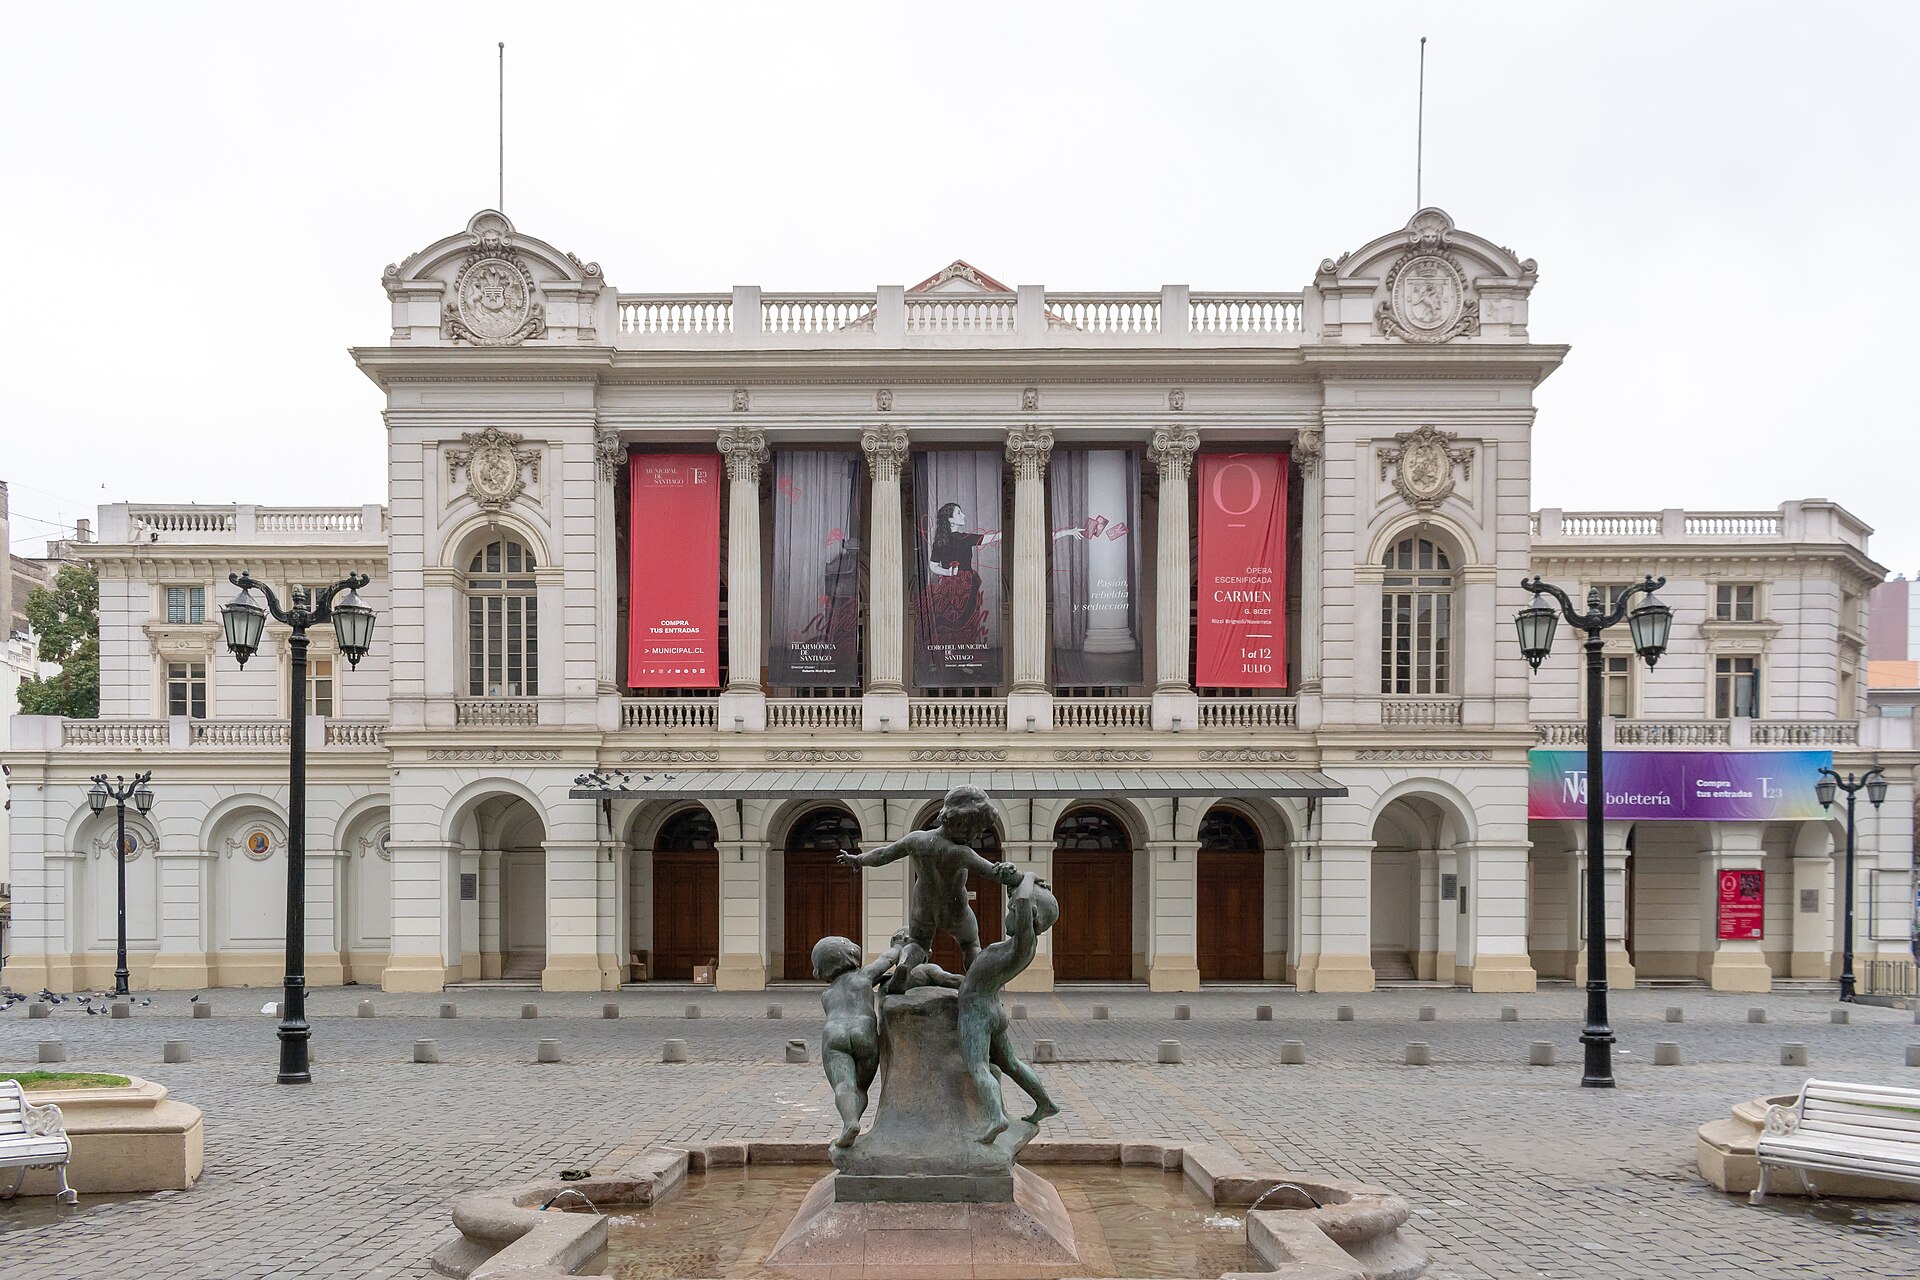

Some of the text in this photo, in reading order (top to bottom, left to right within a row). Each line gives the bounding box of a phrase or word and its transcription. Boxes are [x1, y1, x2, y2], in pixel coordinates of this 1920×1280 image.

[1246, 566, 1272, 574] ÓPERA
[1096, 577, 1128, 587] Pasión,
[1215, 576, 1272, 584] ESCENIFICADA
[1091, 589, 1129, 599] rebeldía
[1214, 590, 1271, 603] CARMEN
[1072, 601, 1129, 613] y seducción
[1240, 647, 1272, 659] 1 al 12
[1241, 663, 1272, 674] JULIO
[1696, 779, 1731, 788] Compra
[1605, 790, 1671, 805] boletería
[1713, 790, 1753, 798] entradas
